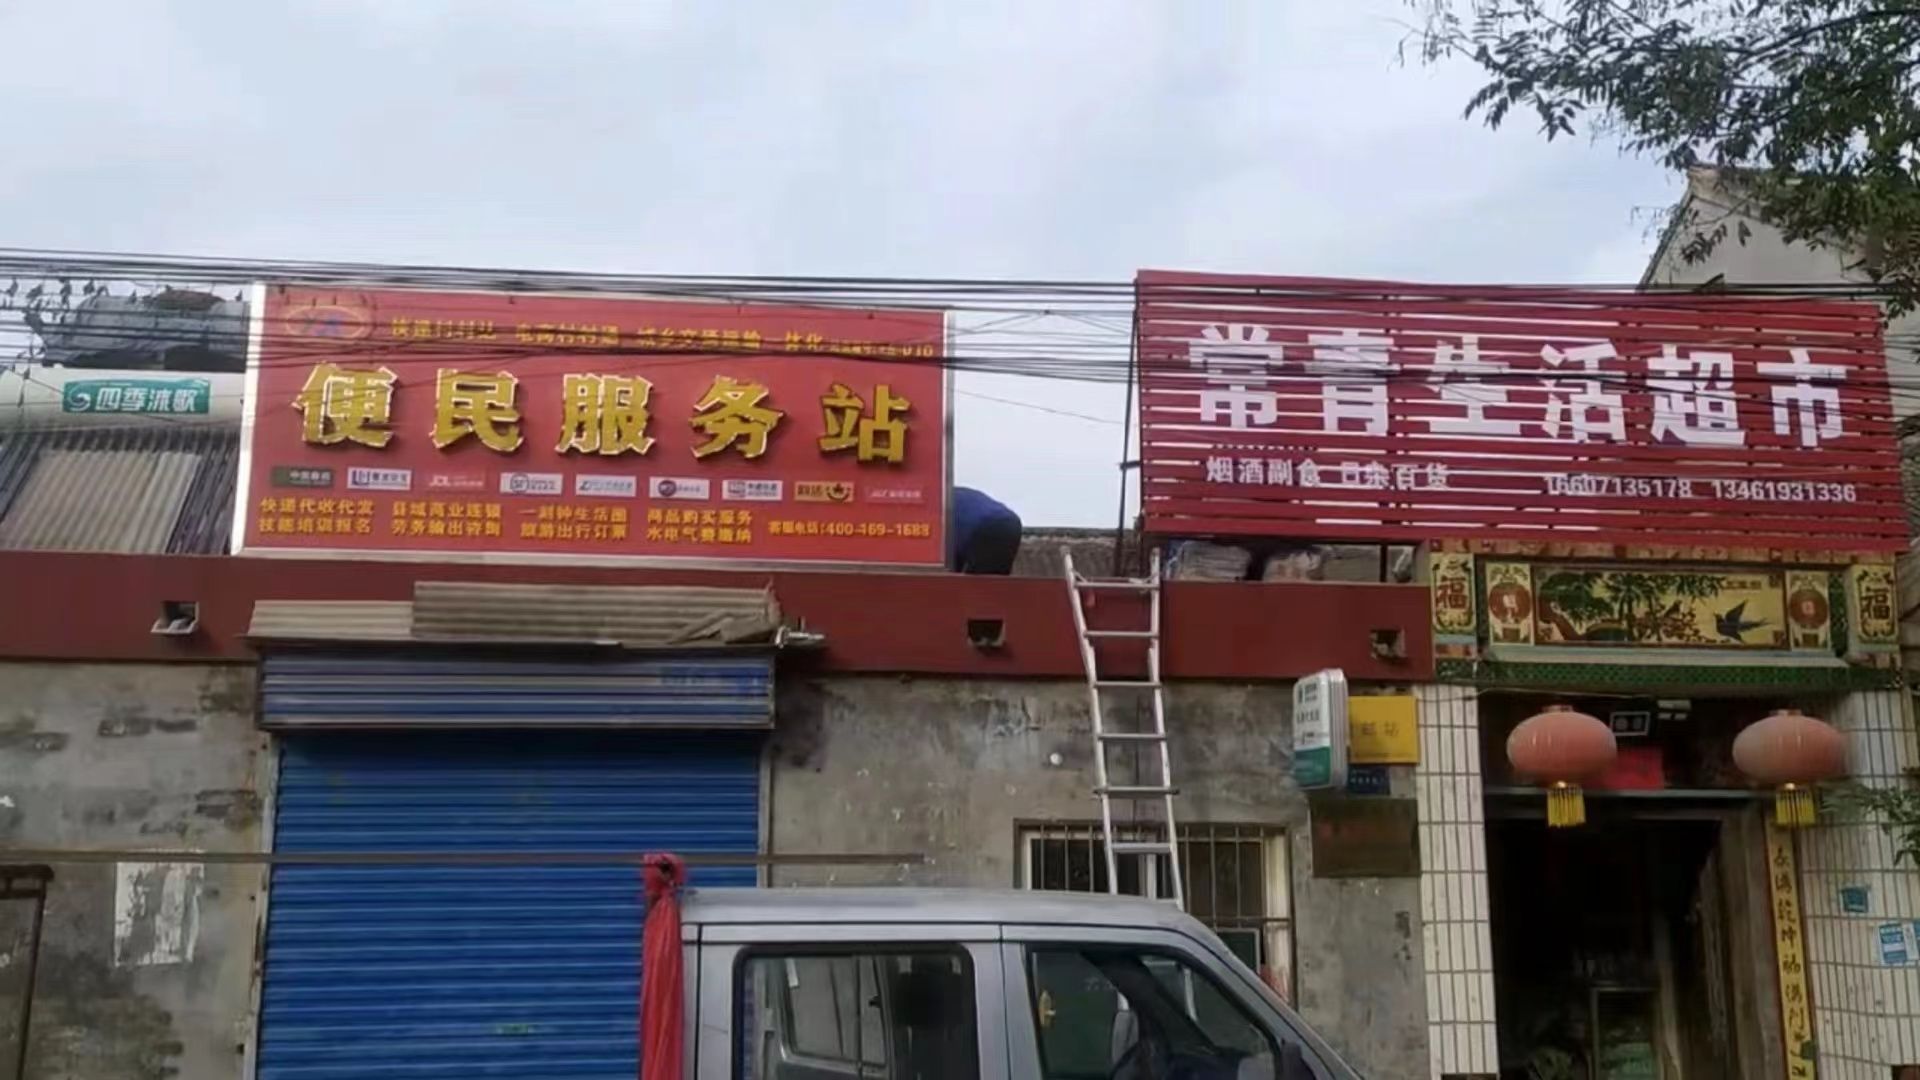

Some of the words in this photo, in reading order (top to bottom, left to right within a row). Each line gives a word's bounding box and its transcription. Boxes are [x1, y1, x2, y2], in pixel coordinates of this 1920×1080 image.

[95, 386, 200, 413] 四季沐歌
[1189, 322, 1847, 449] 常青生活超市
[291, 361, 911, 463] 便民服务站
[1205, 455, 1321, 487] 烟酒副食
[1710, 479, 1857, 503] 13461931336
[260, 498, 374, 515] 快递代收代发
